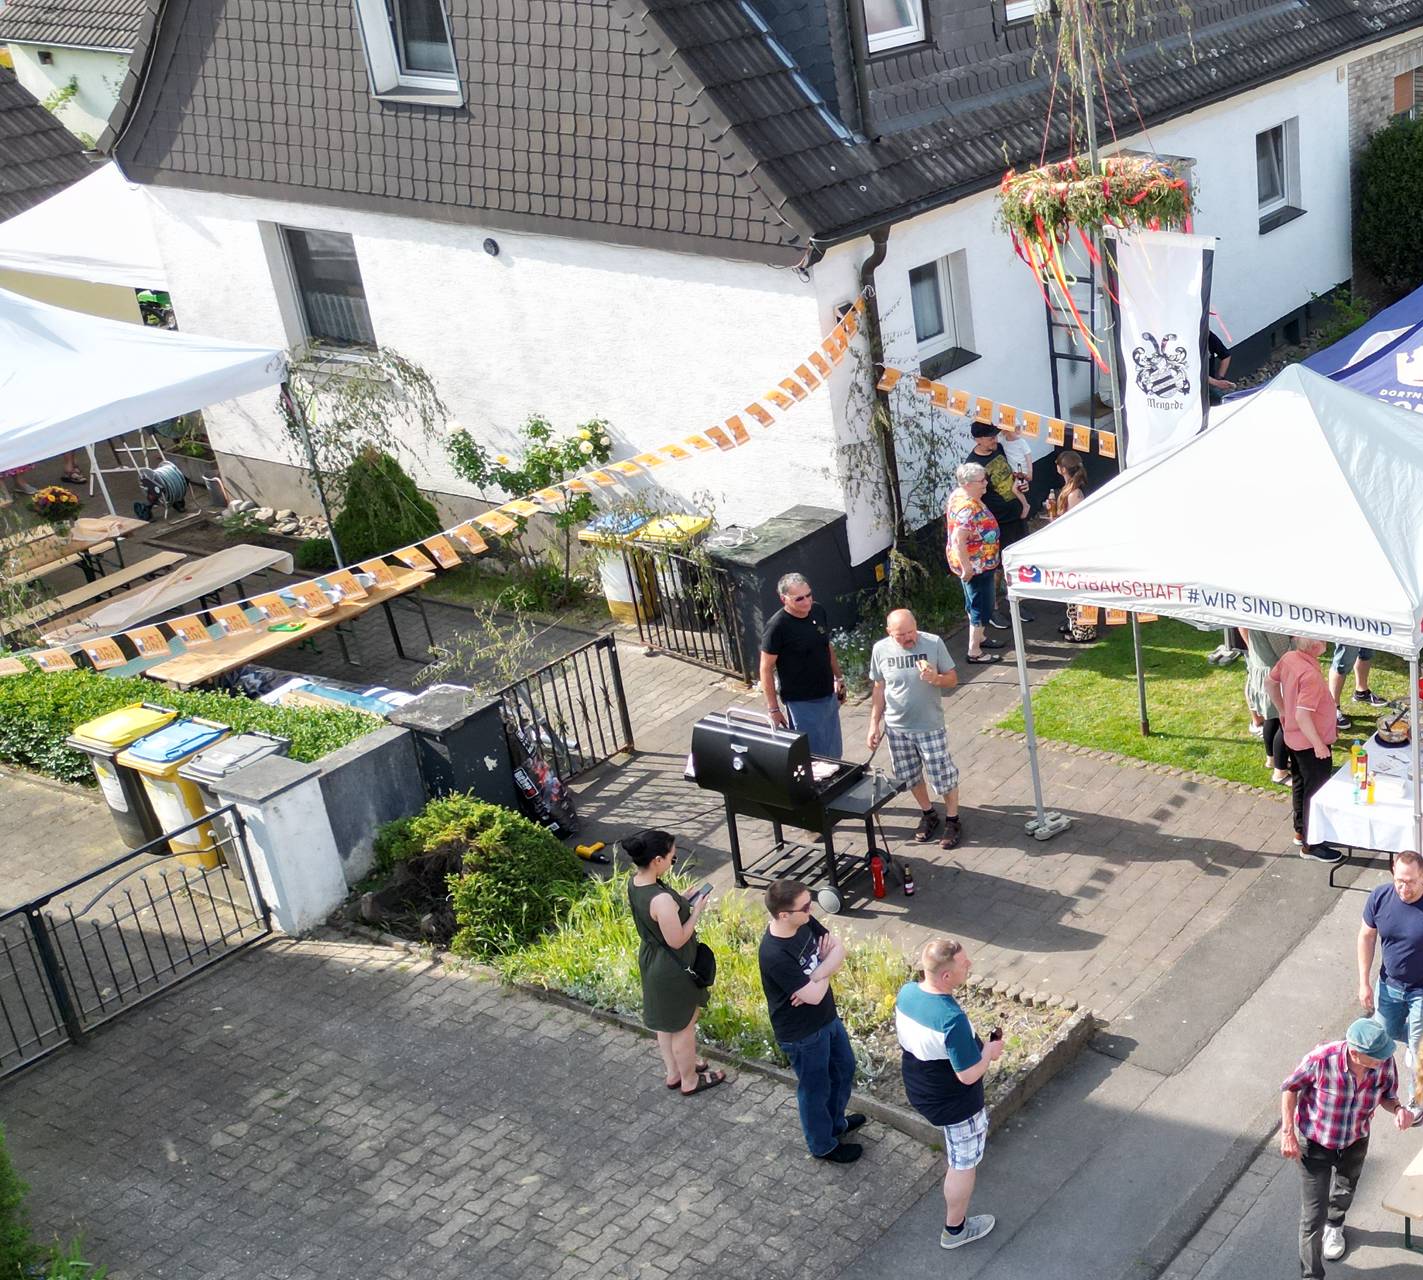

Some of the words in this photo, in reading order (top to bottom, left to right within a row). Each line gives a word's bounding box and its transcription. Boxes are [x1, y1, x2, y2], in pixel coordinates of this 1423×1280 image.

[1044, 570, 1185, 601] NACHBARSCHAFT
[1242, 596, 1283, 618] SIND
[1289, 604, 1392, 637] DORTMUND
